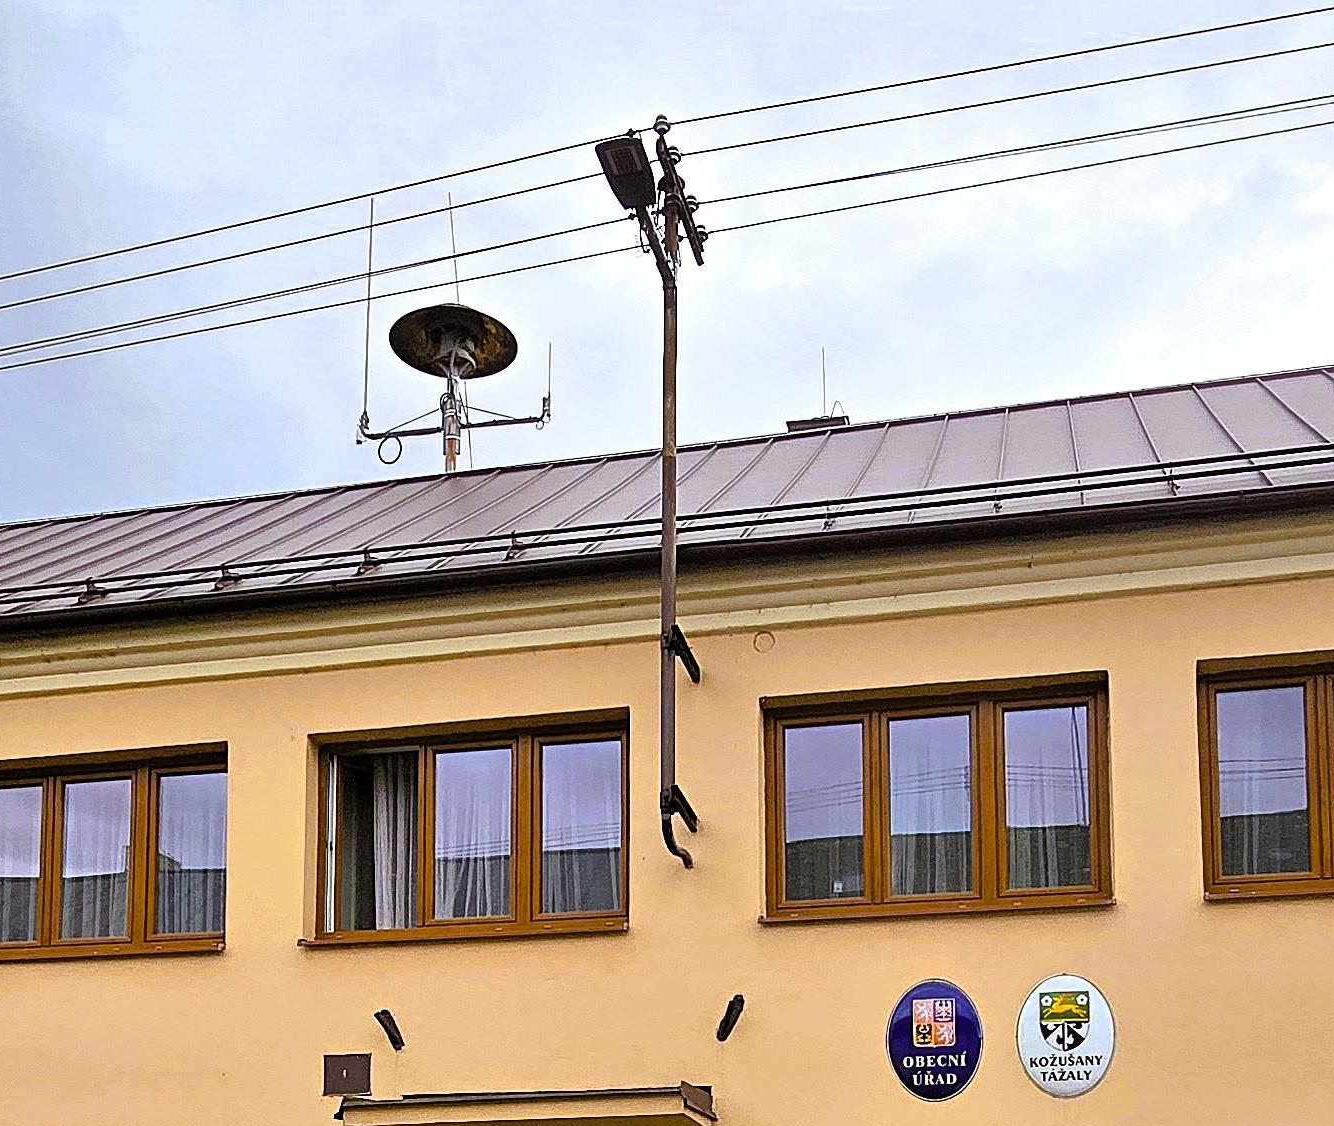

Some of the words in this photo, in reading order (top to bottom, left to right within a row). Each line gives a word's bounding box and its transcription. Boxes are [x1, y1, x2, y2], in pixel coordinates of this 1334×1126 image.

[903, 1051, 967, 1068] OBECNÍ
[1030, 1054, 1103, 1068] KOŽUŠANY
[913, 1071, 957, 1086] ÚŘAD
[1040, 1069, 1092, 1081] TÁŽALY
